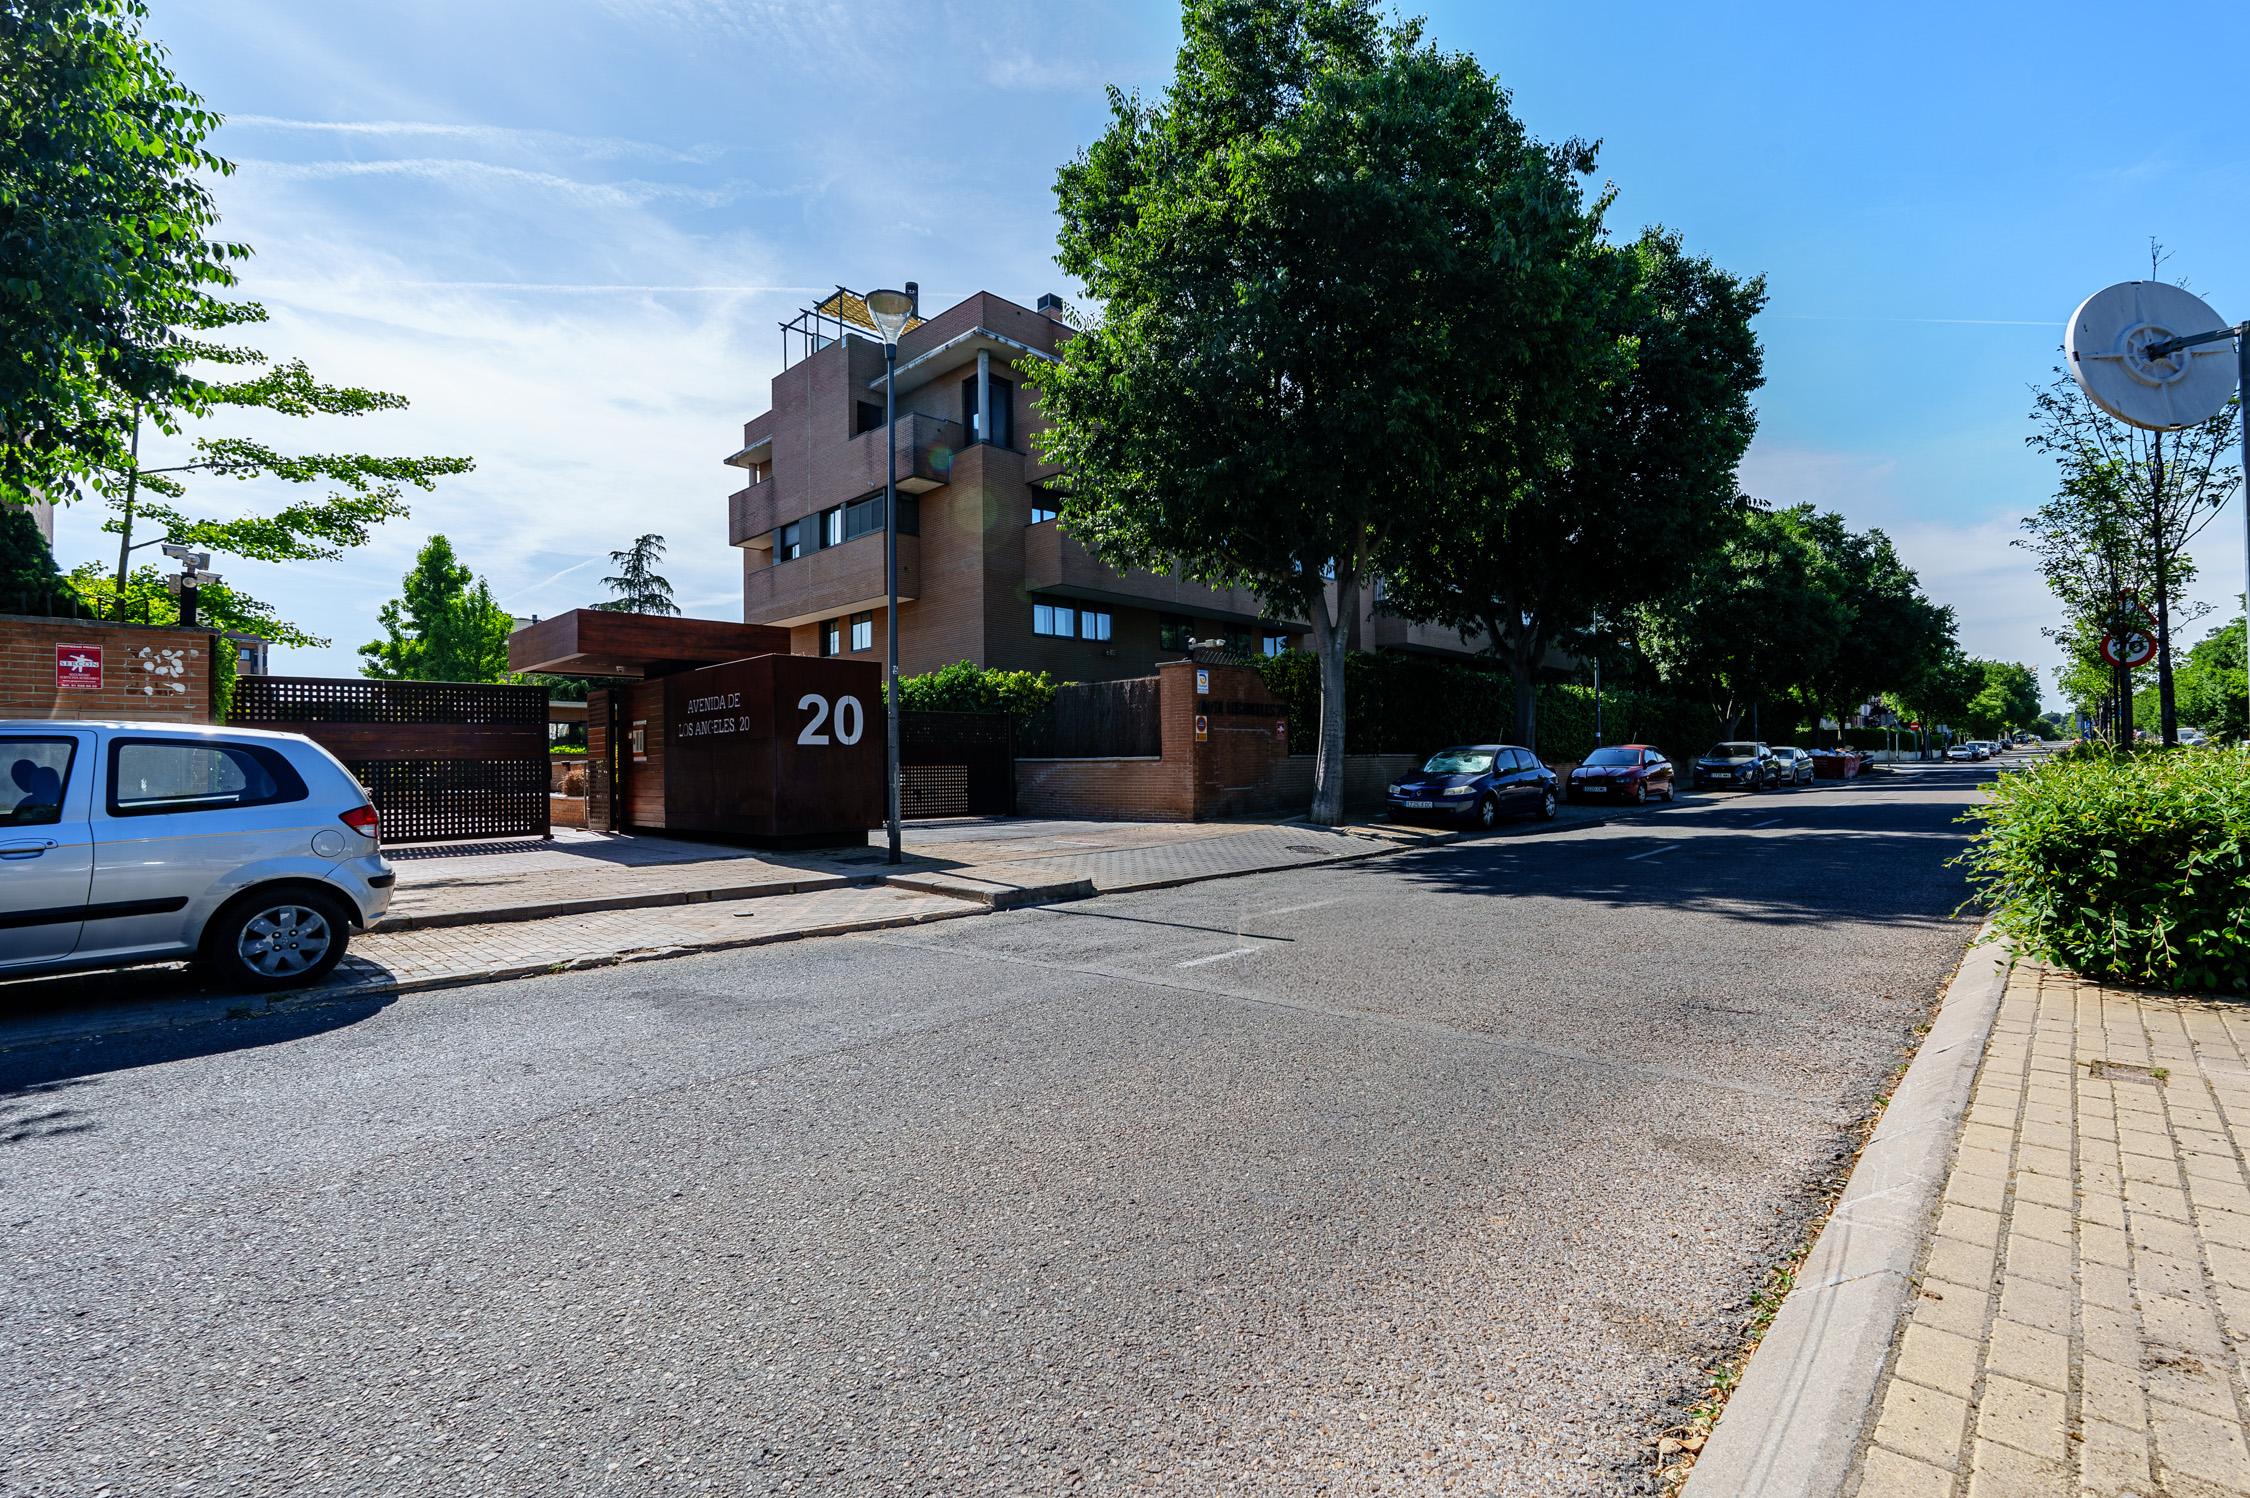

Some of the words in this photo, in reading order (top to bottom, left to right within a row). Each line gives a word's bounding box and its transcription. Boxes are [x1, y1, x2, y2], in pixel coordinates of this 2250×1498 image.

[687, 695, 726, 714] AVENIDA
[727, 692, 741, 708] DE
[678, 722, 694, 737] LOS
[739, 715, 751, 732] 20
[797, 693, 864, 746] 20
